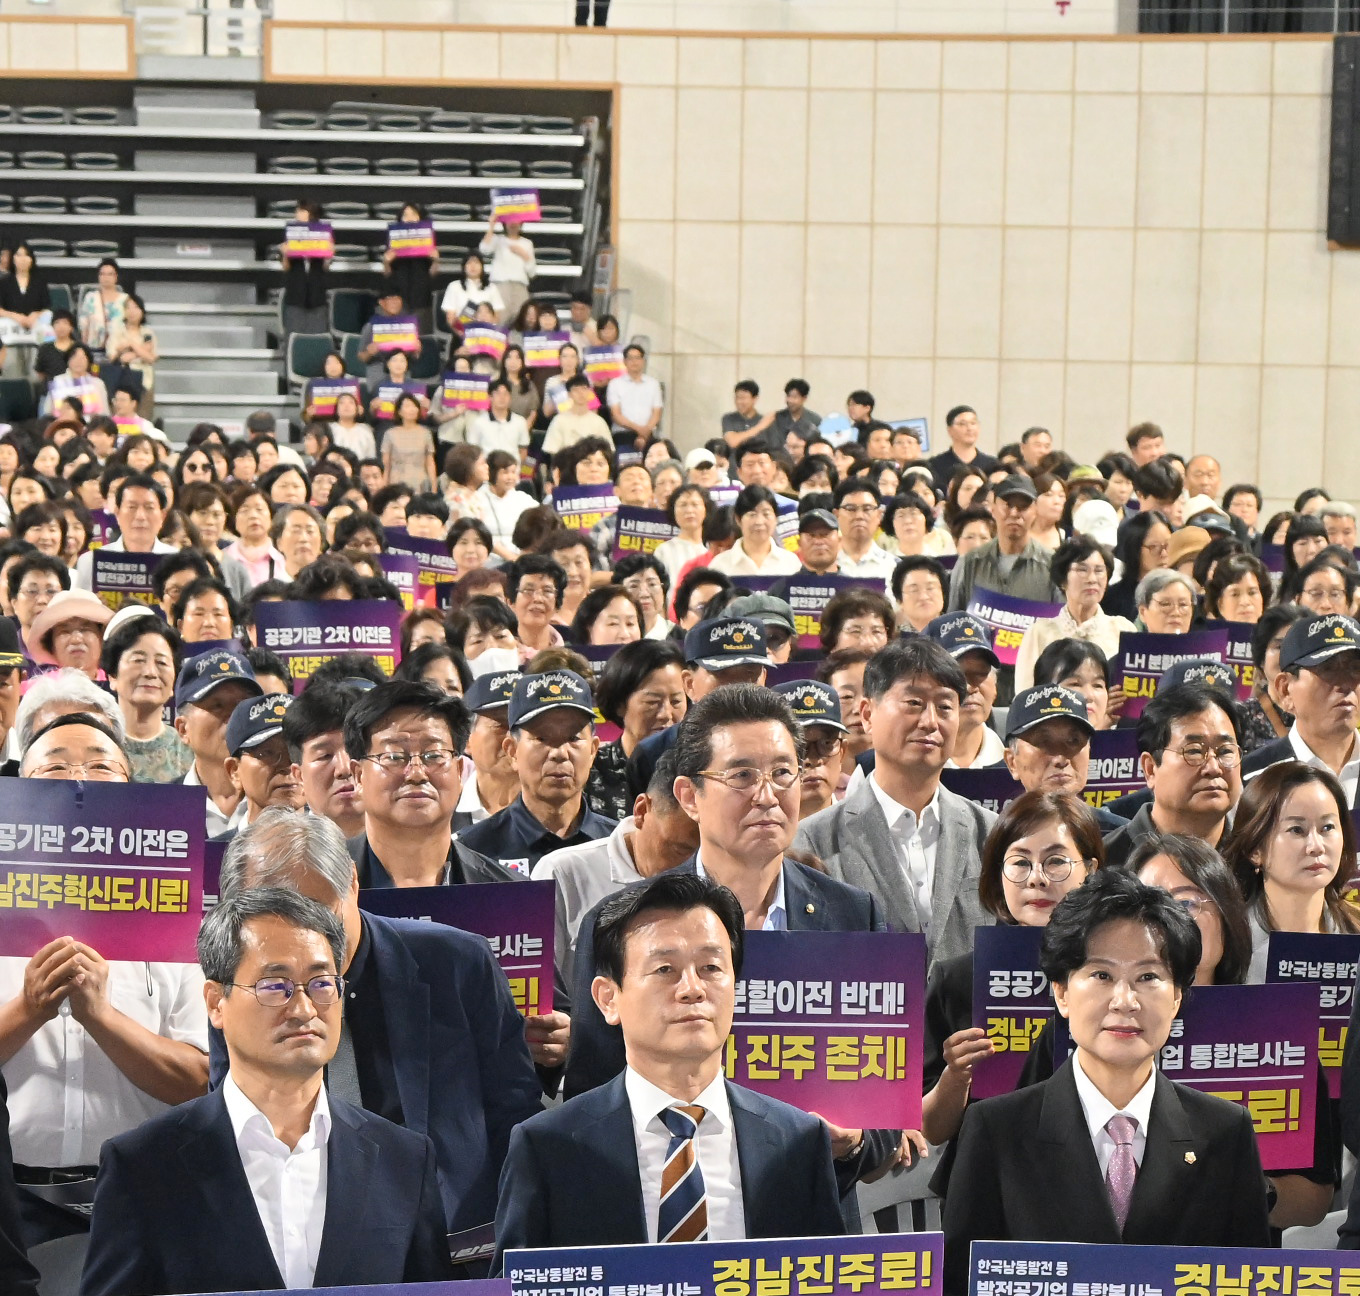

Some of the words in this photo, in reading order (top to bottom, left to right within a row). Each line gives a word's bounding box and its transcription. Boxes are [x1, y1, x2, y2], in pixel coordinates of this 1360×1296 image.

[265, 627, 322, 646] 공공기관
[325, 626, 350, 643] 2차
[353, 626, 391, 644] 이전은
[1125, 653, 1145, 669] LH
[1123, 676, 1156, 698] 본사
[71, 827, 114, 854] 2차
[119, 827, 188, 858] 이전은
[840, 981, 905, 1016] 반대!
[745, 1033, 820, 1080] 진주
[825, 1035, 906, 1081] 존치!
[1189, 1041, 1305, 1071] 통합본사는
[510, 1266, 588, 1283] 한국남동발전
[591, 1266, 603, 1281] 등
[978, 1259, 1053, 1276] 한국남동발전
[1056, 1261, 1068, 1277] 등
